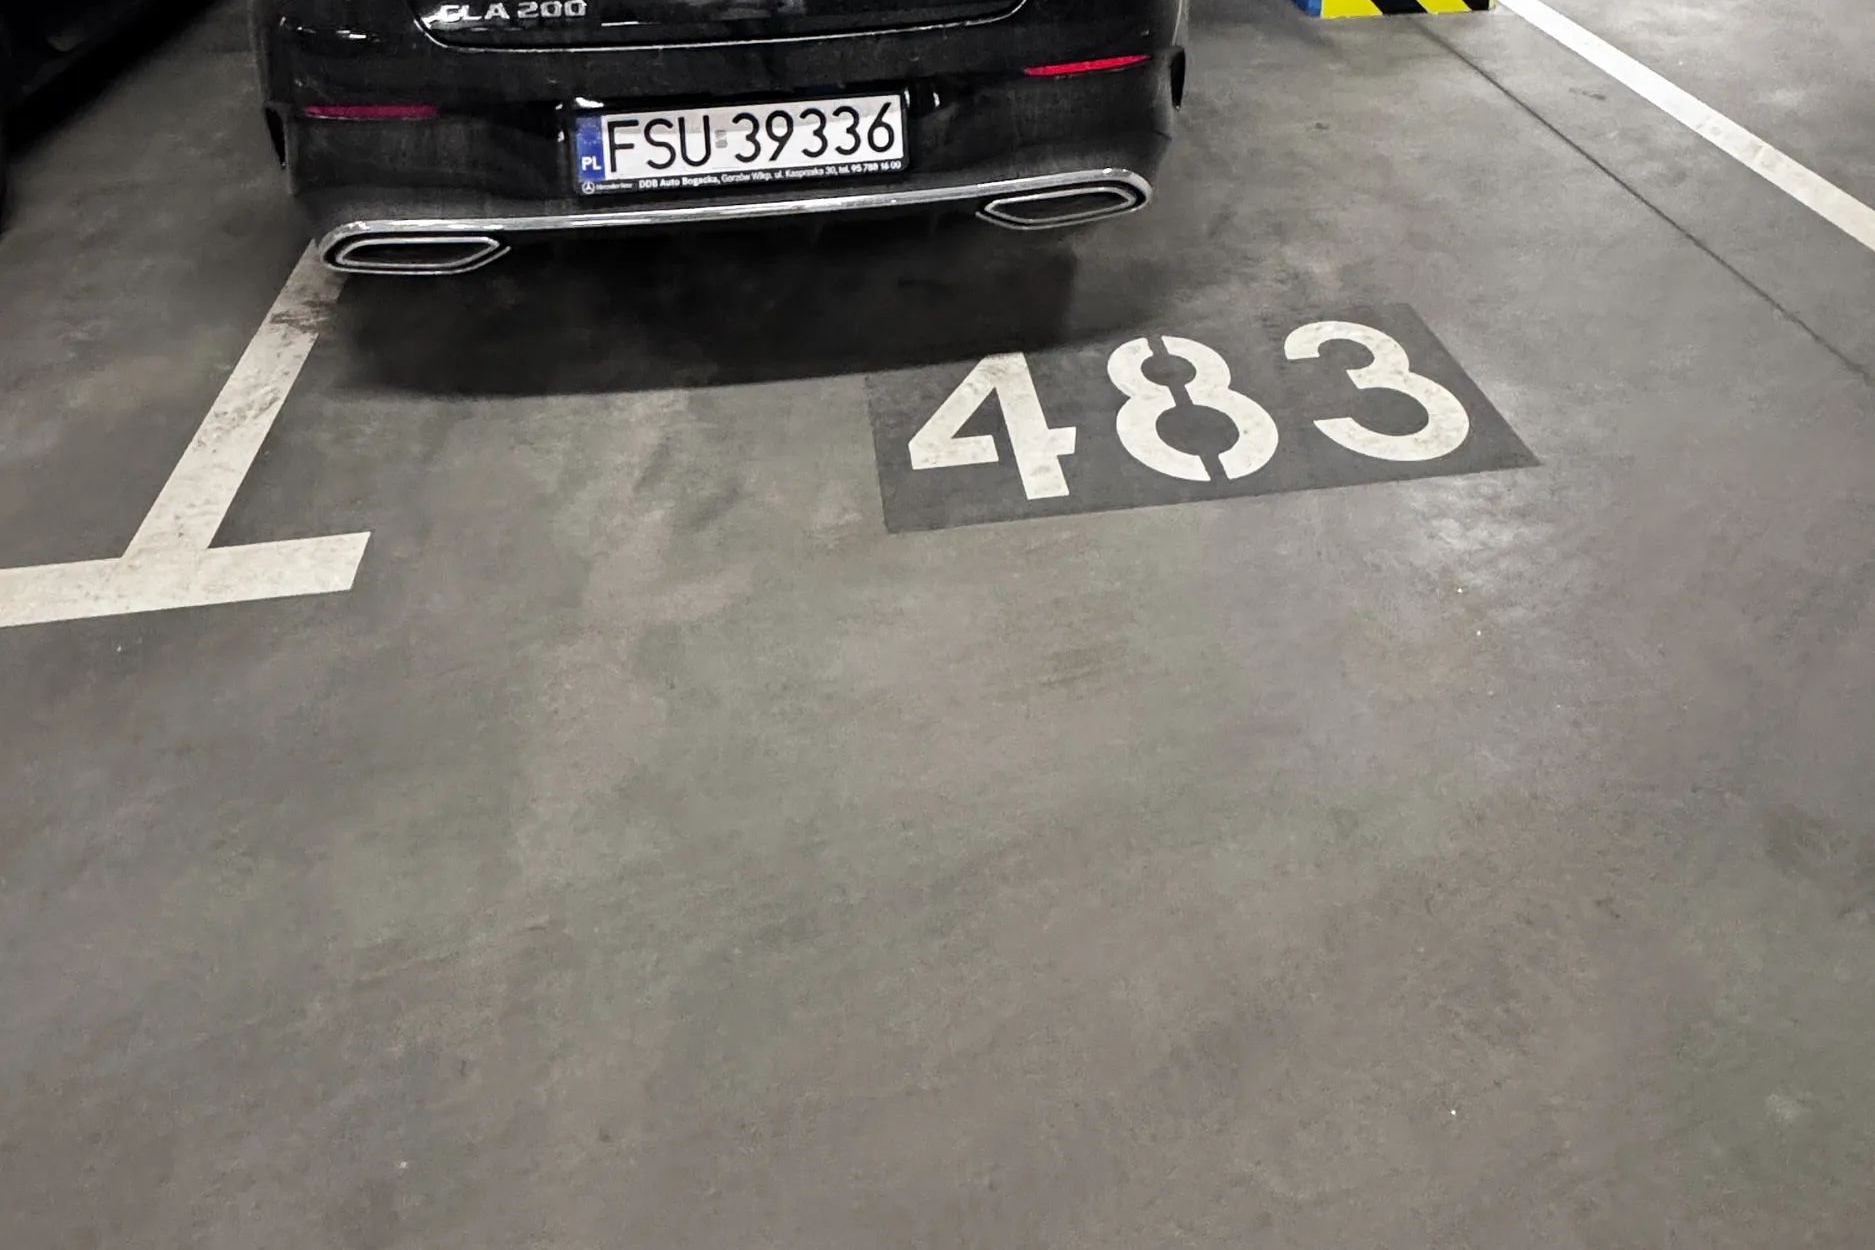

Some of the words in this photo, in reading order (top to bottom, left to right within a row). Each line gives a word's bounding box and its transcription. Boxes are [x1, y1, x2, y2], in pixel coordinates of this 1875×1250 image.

[517, 0, 587, 18] 200
[607, 114, 713, 173] FSU
[731, 102, 896, 163] 39336
[581, 156, 601, 170] PL
[638, 179, 658, 189] DDB
[660, 177, 681, 187] Auto
[908, 320, 1470, 500] 483
